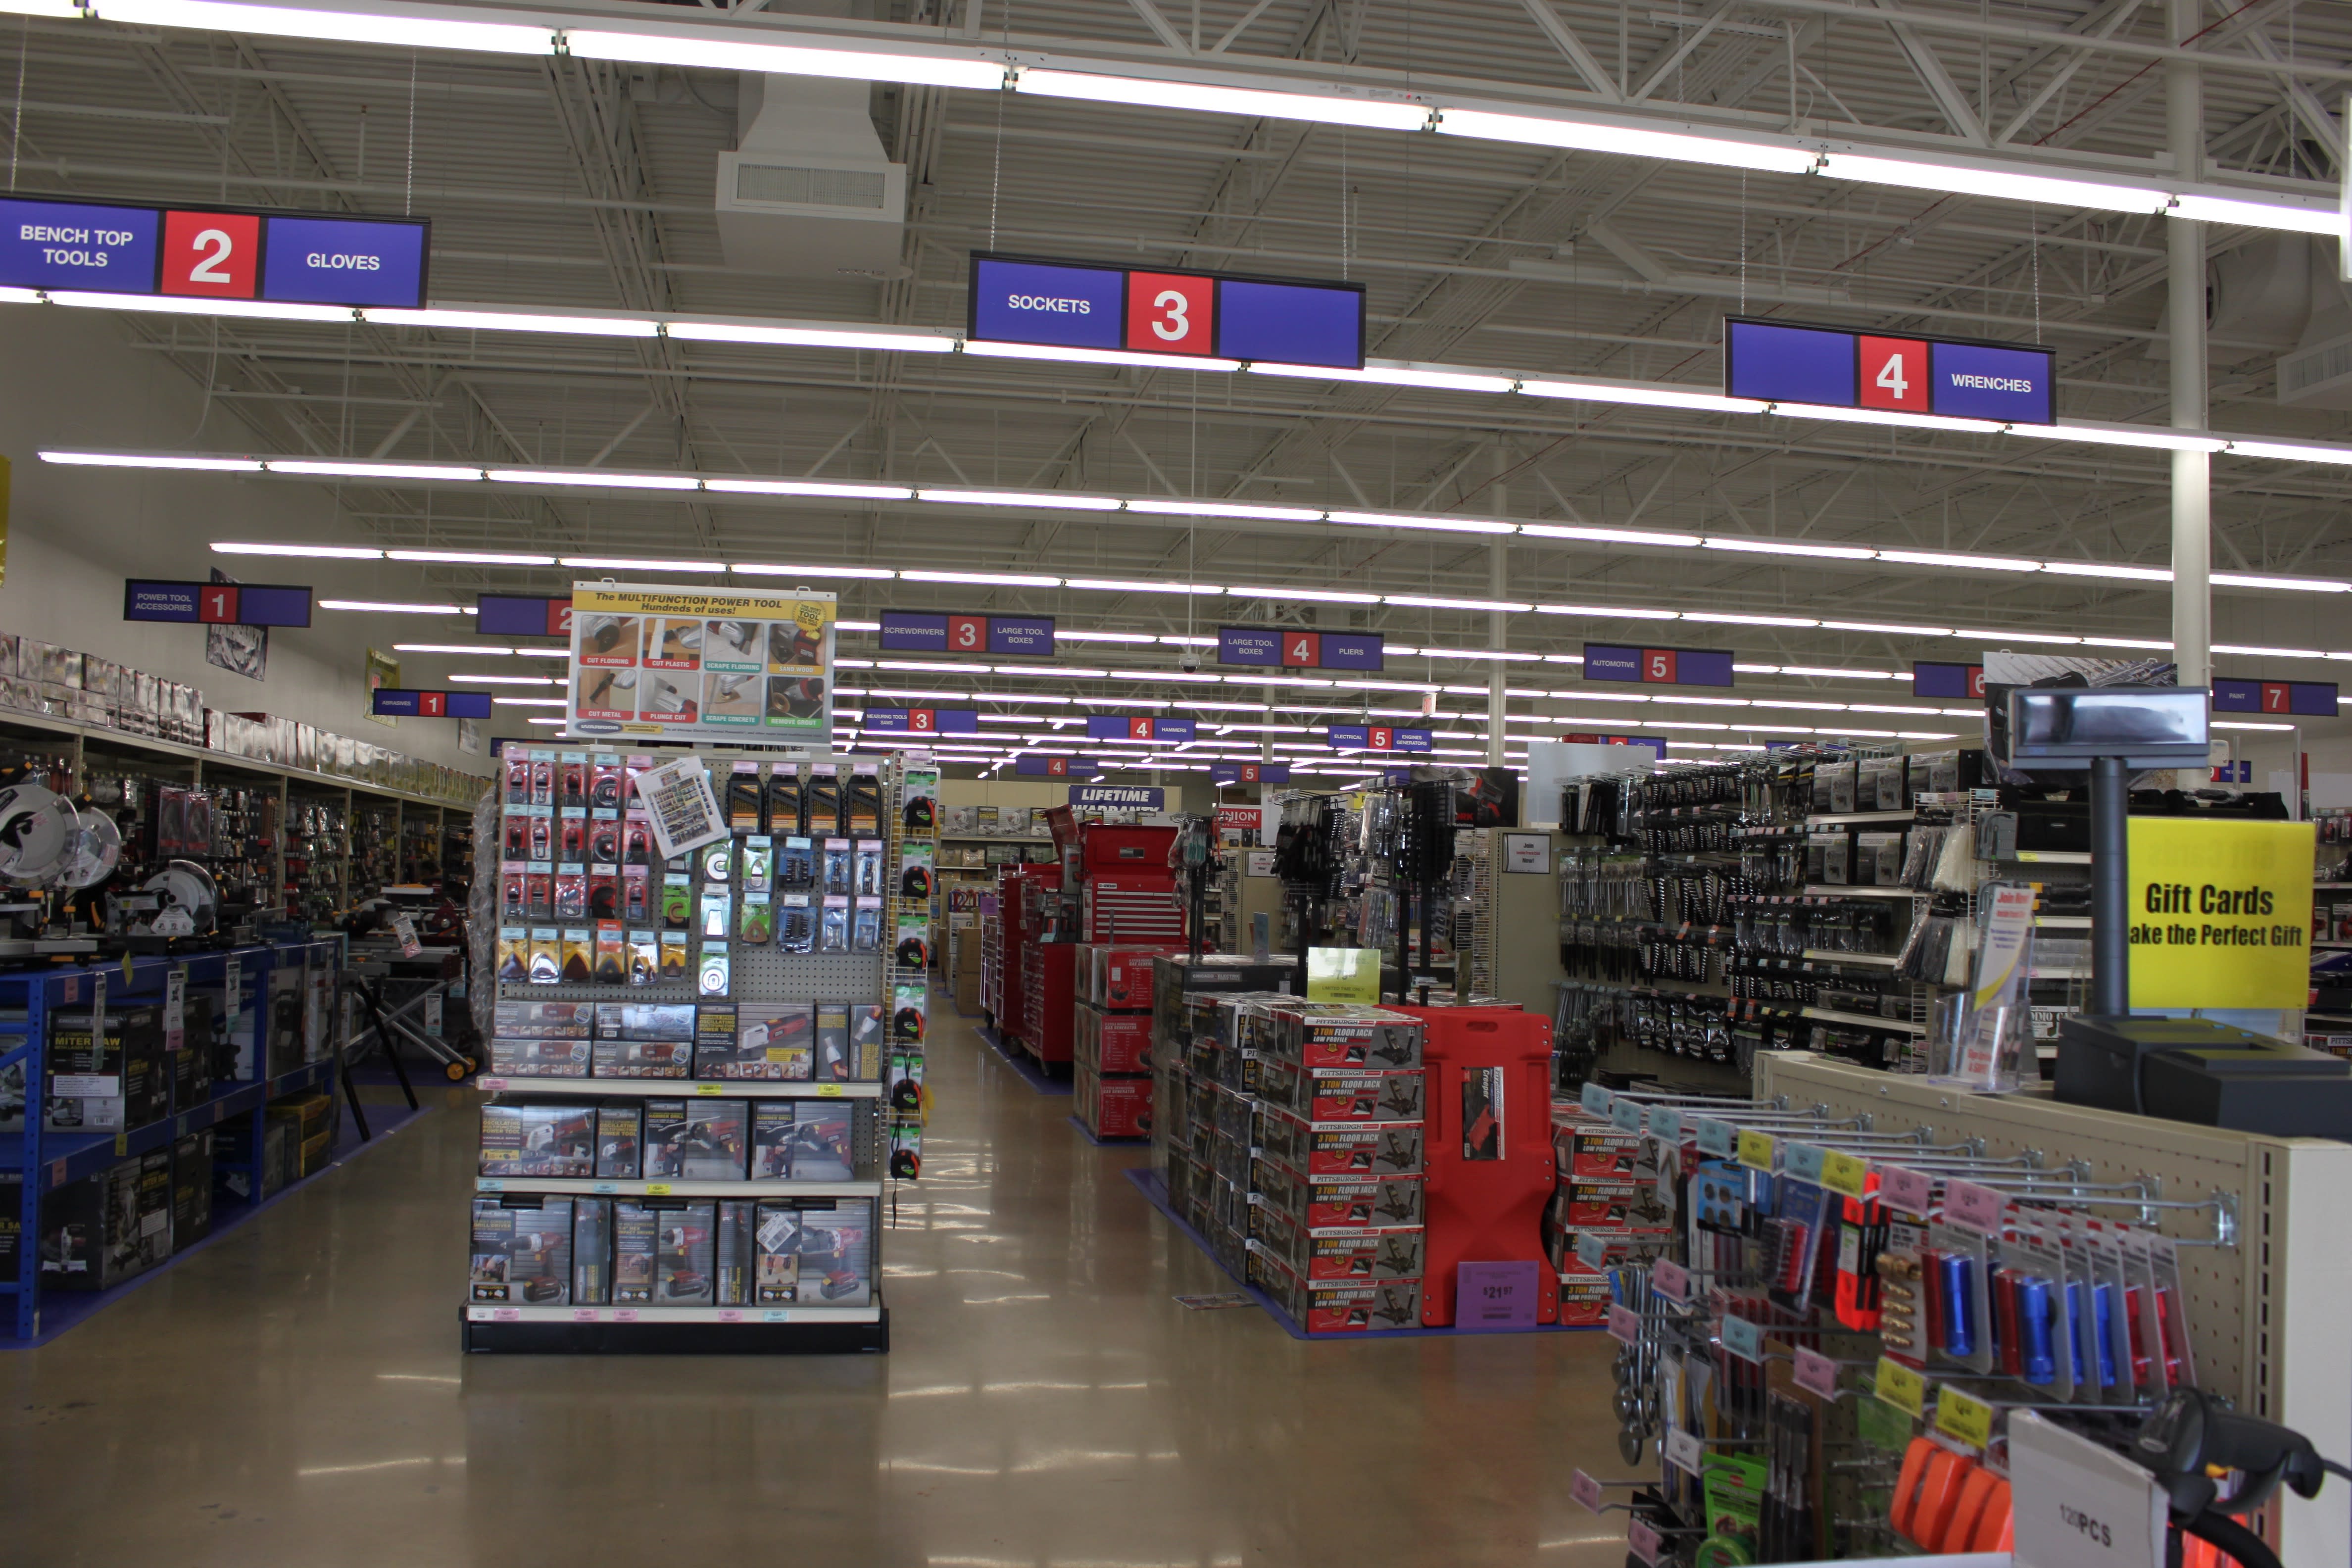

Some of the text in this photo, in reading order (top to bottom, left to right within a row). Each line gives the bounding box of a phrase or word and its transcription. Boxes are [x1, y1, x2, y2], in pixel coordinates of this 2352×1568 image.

[20, 225, 133, 246] BENCH TOP
[44, 249, 108, 267] TOOLS
[190, 229, 233, 284] 2
[306, 253, 380, 271] GLOVES
[1008, 295, 1090, 314] SOCKETS
[1152, 290, 1189, 342] 3
[1876, 353, 1908, 399] 4
[1952, 374, 2032, 393] WRENCHES
[137, 592, 192, 603] POWER TOOL
[211, 594, 224, 618] 1
[596, 592, 782, 608] The MULTIFUNCTION POWER TOOL
[135, 601, 193, 612] ACCESSORIES
[641, 603, 691, 612] Hundreds
[559, 607, 573, 631] 2
[799, 610, 819, 621] TOOL
[884, 627, 945, 636] SCREWDRIVERS
[959, 623, 976, 646] 3
[1293, 639, 1309, 661] 4
[1339, 648, 1364, 656] PLIERS
[1592, 660, 1635, 668] AUTOMOTIVE
[1652, 656, 1667, 678] 5
[428, 697, 438, 713] 1
[2269, 689, 2282, 708] 7
[916, 714, 927, 729] 3
[1136, 722, 1147, 737] 4
[1375, 732, 1385, 746] 5
[1053, 761, 1062, 772] 4
[1246, 769, 1254, 779] 5
[1081, 789, 1150, 802] LIFETIME
[2146, 882, 2274, 915] Gift Cards
[2130, 924, 2303, 946] ake the Perfect Gift
[55, 1037, 121, 1046] MITER AW
